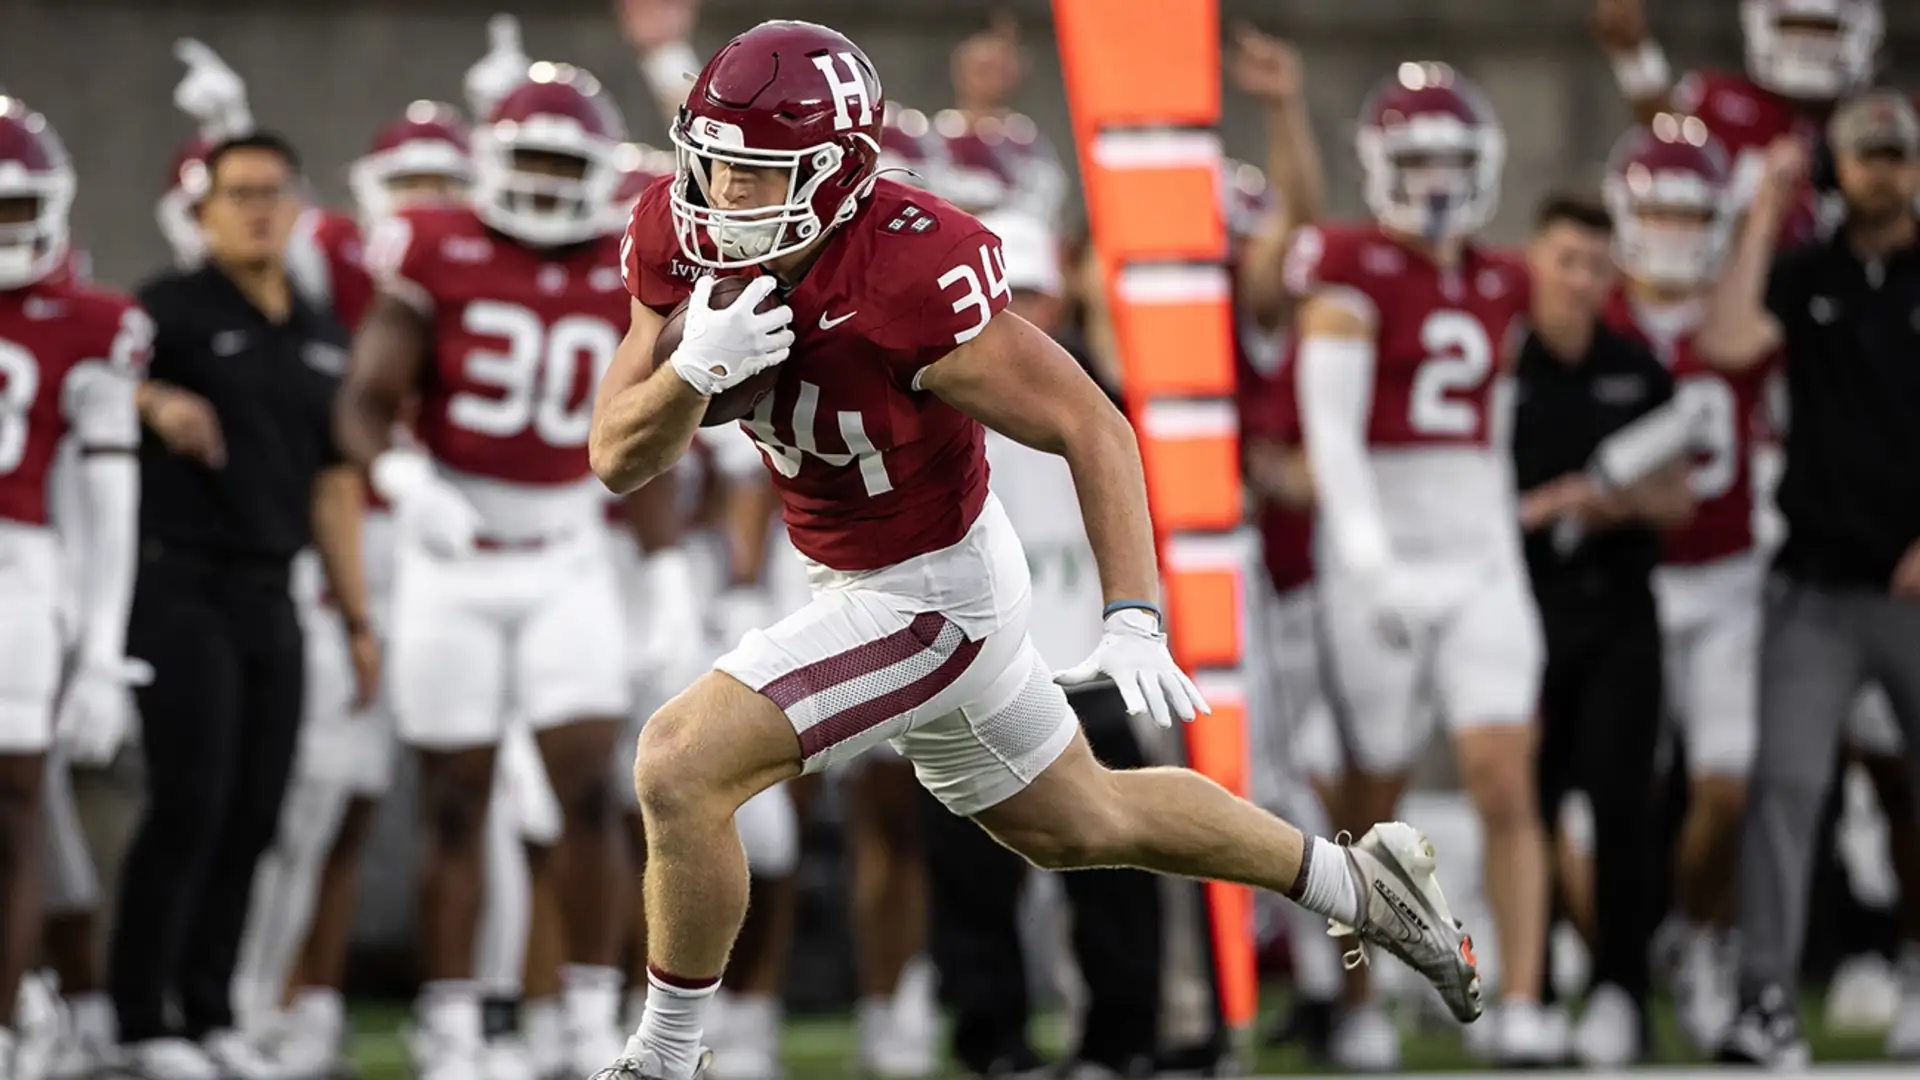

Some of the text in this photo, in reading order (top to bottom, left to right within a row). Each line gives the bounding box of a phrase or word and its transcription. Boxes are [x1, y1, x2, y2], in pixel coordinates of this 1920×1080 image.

[811, 51, 873, 131] H
[671, 258, 701, 282] Ivy
[937, 243, 1012, 345] 34
[446, 300, 621, 447] 30
[1409, 309, 1493, 435] 2
